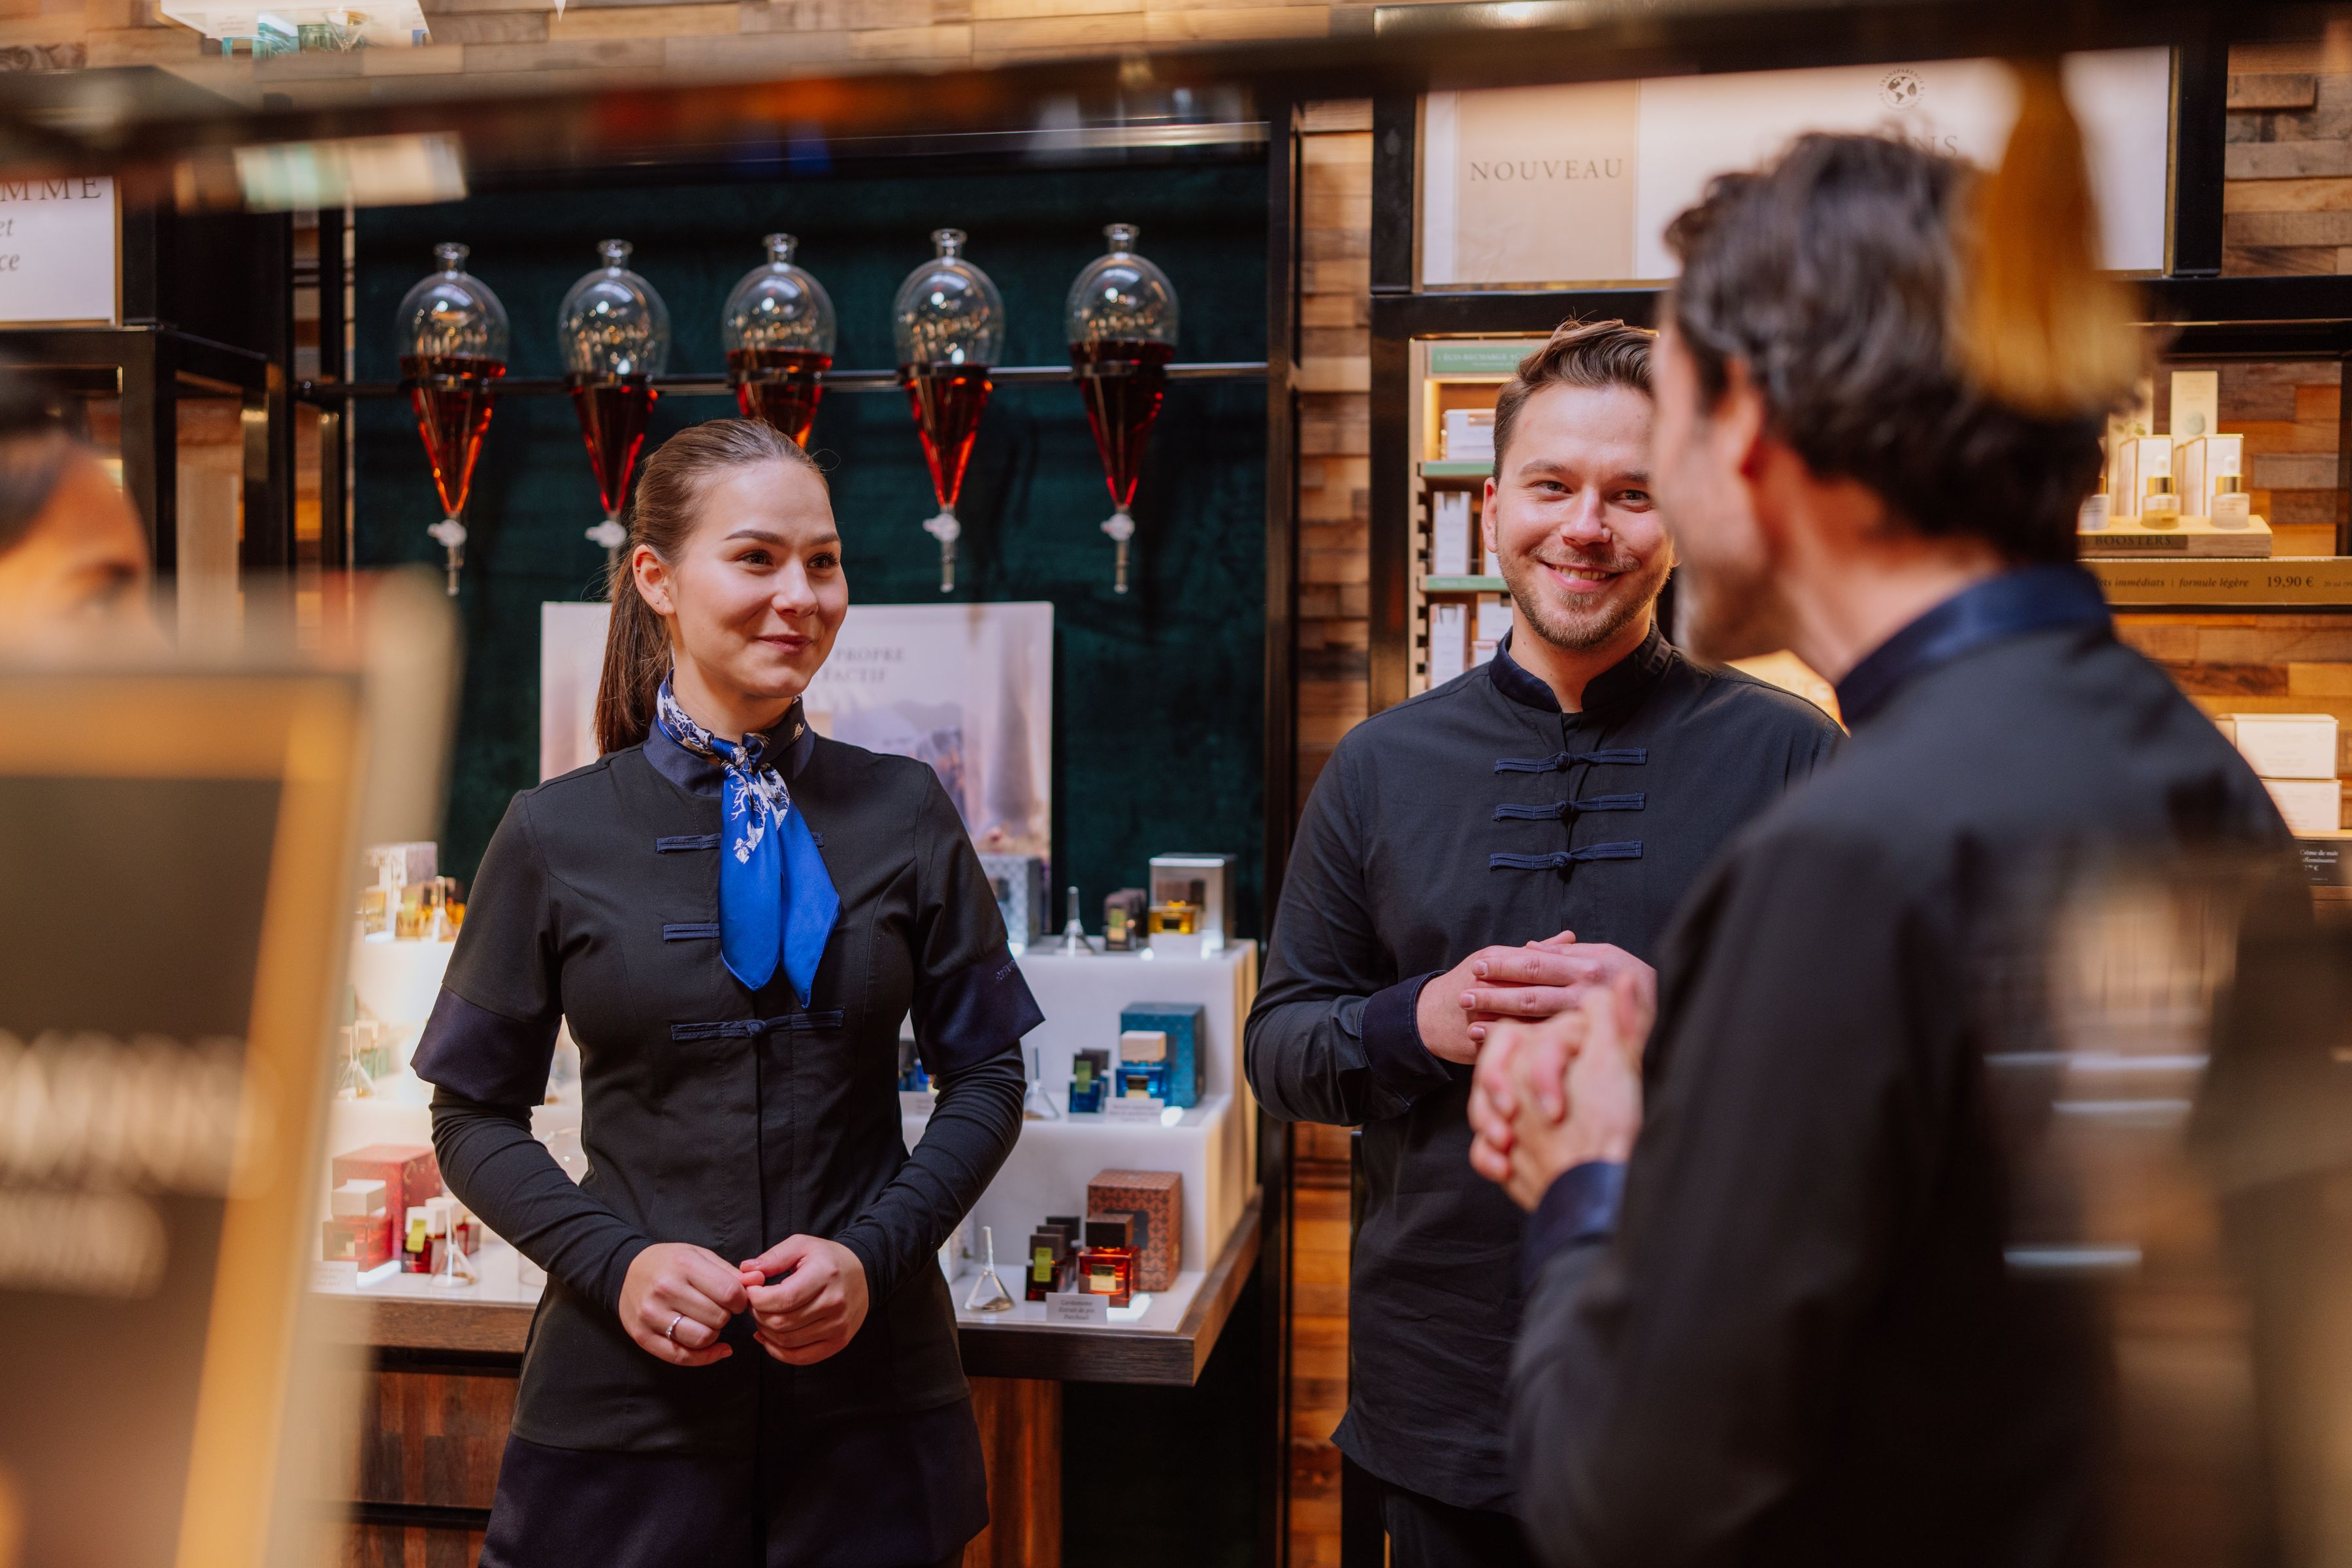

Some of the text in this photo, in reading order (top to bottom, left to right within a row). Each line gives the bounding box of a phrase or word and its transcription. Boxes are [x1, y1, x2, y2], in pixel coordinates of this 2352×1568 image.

[1470, 159, 1623, 181] NOUVEAU
[2095, 535, 2172, 545] BOOSTERS
[2179, 578, 2217, 588] formule
[2219, 578, 2249, 589] légère
[2267, 576, 2302, 587] 19,90
